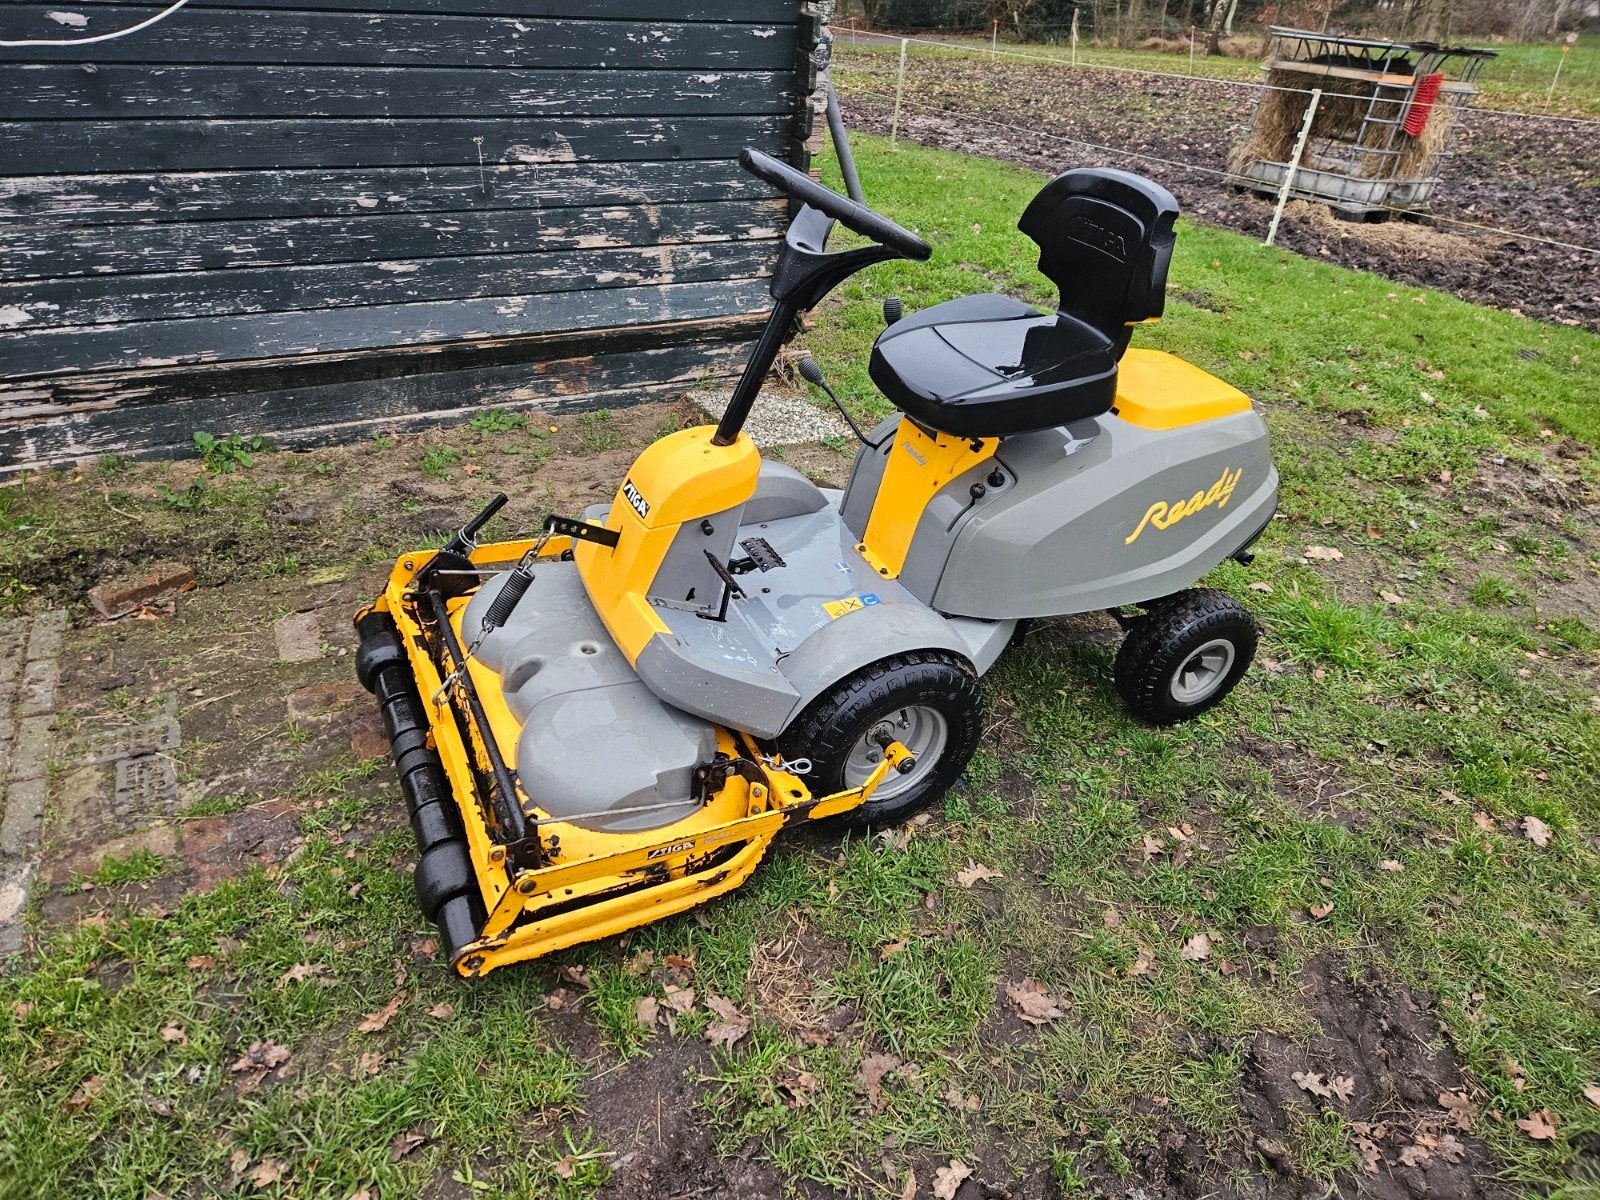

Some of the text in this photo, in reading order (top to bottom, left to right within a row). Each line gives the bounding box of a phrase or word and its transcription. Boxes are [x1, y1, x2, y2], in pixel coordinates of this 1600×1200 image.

[623, 483, 647, 518] STIGA
[1125, 466, 1242, 545] Ready
[648, 840, 695, 860] STIGA
